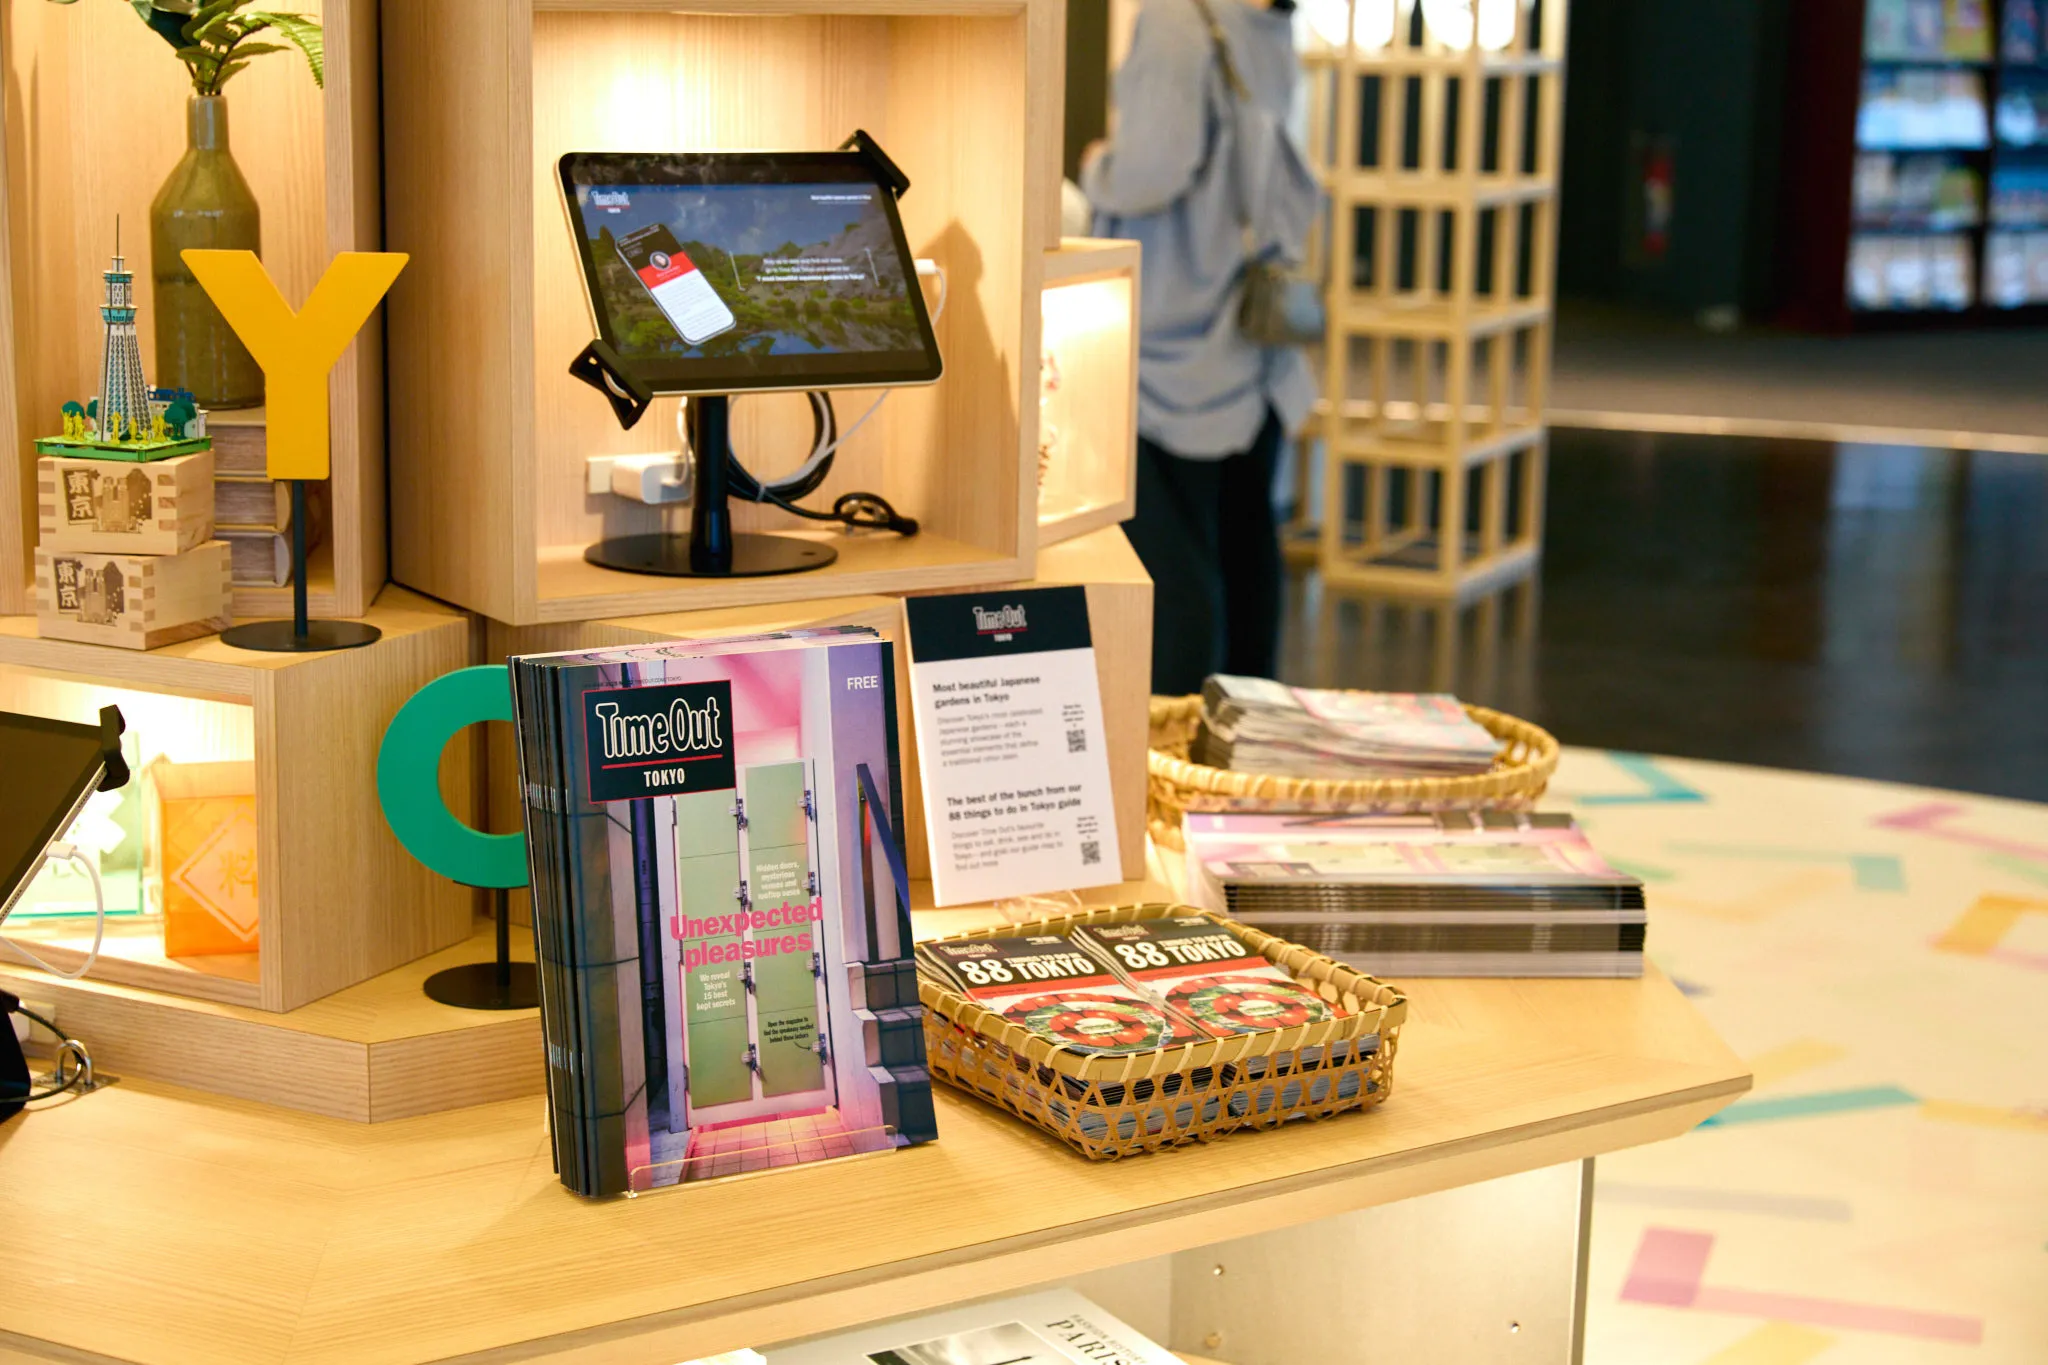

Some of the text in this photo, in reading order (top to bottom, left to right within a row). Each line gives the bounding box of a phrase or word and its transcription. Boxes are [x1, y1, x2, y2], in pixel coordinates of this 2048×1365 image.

[180, 249, 410, 480] Y
[66, 471, 94, 520] 東京
[56, 560, 79, 608] 東京
[847, 675, 879, 690] FREE
[933, 676, 1041, 693] Most beautiful Japanese
[935, 693, 1010, 709] gardens in Tokyo
[644, 768, 686, 787] TOKYO
[947, 784, 1082, 807] The best of the bunch from our
[964, 808, 991, 819] things
[994, 807, 1003, 816] to
[1006, 805, 1017, 814] do
[1020, 804, 1028, 812] in
[1030, 800, 1056, 811] Tokyo
[1058, 799, 1081, 810] guide
[756, 863, 779, 873] Hidden
[761, 871, 796, 882] mysterious
[784, 879, 797, 888] and
[758, 890, 782, 900] rooftop
[670, 896, 823, 940] Unexpected
[684, 933, 813, 973] pleasures
[1114, 940, 1247, 969] 88 TOKYO
[699, 970, 731, 983] We reveal
[957, 957, 1096, 985] 88 TOKYO
[704, 981, 728, 992] Tokyo's
[703, 990, 728, 1001] 15 best
[696, 998, 736, 1012] kept secrets
